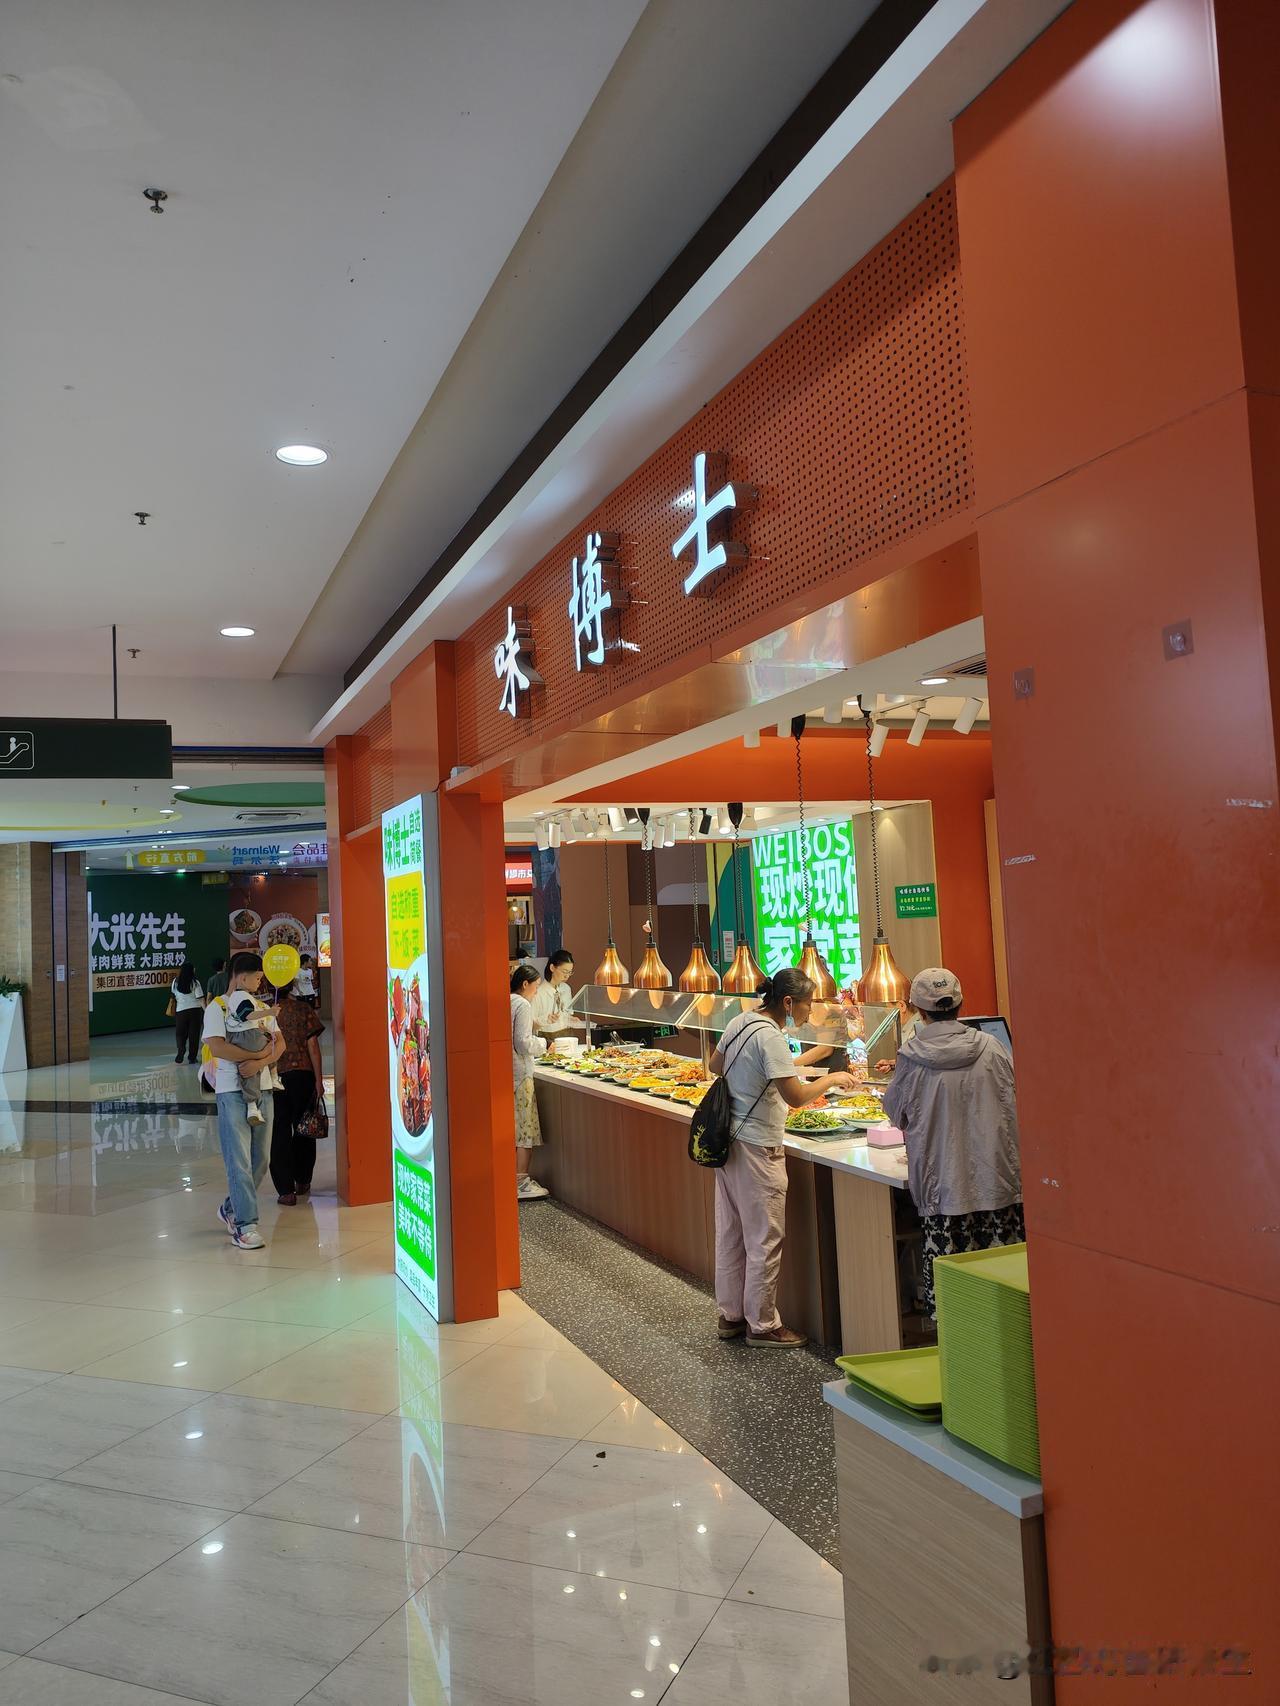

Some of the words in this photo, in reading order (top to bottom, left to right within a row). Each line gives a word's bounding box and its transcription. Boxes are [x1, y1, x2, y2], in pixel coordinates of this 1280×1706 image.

[494, 451, 737, 719] 味博士
[384, 815, 410, 871] 味博士
[752, 822, 851, 868] WEIBOS
[92, 912, 186, 951] 大米先生
[140, 951, 186, 968] 大厨现炒
[398, 1200, 432, 1260] 美味不等待
